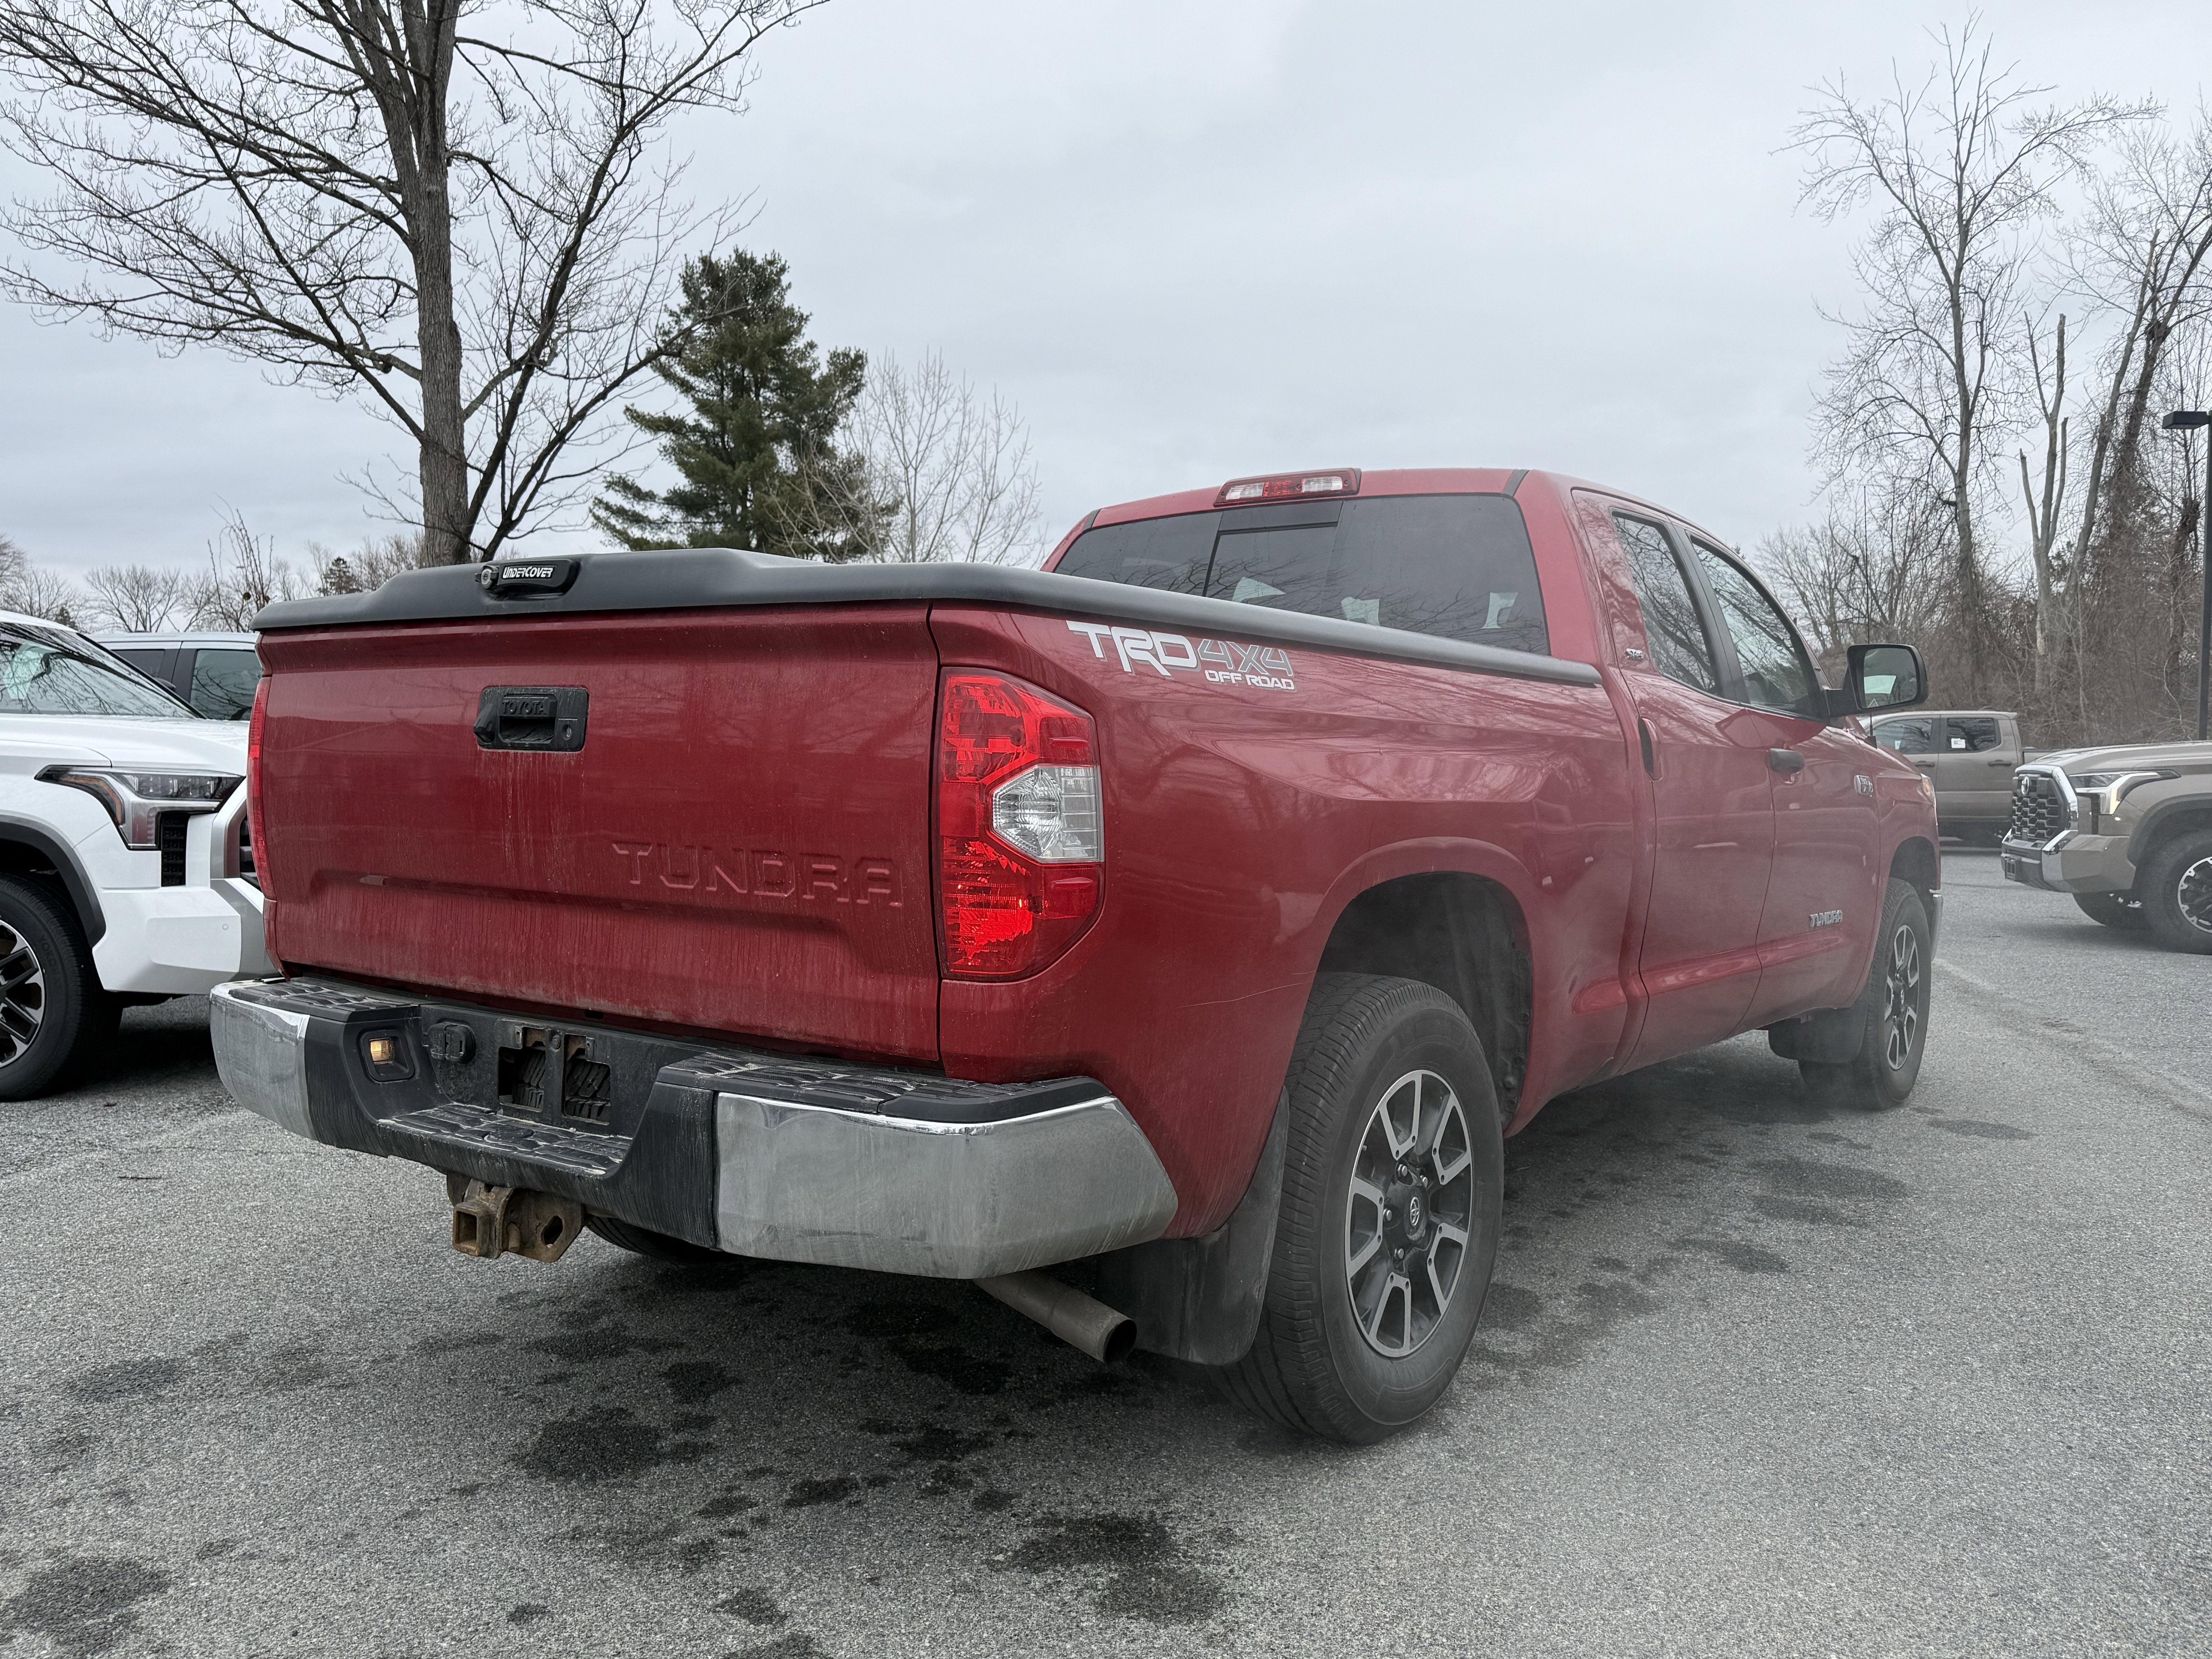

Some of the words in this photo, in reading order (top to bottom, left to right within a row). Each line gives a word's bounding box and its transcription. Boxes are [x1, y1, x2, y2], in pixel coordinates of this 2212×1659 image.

[1066, 620, 1200, 678] TRD
[1205, 669, 1242, 685] OFF
[1245, 674, 1295, 690] ROAD
[502, 700, 548, 715] TOYOTA
[612, 841, 904, 908] TUNDRA
[1810, 910, 1843, 927] TUNDRA
